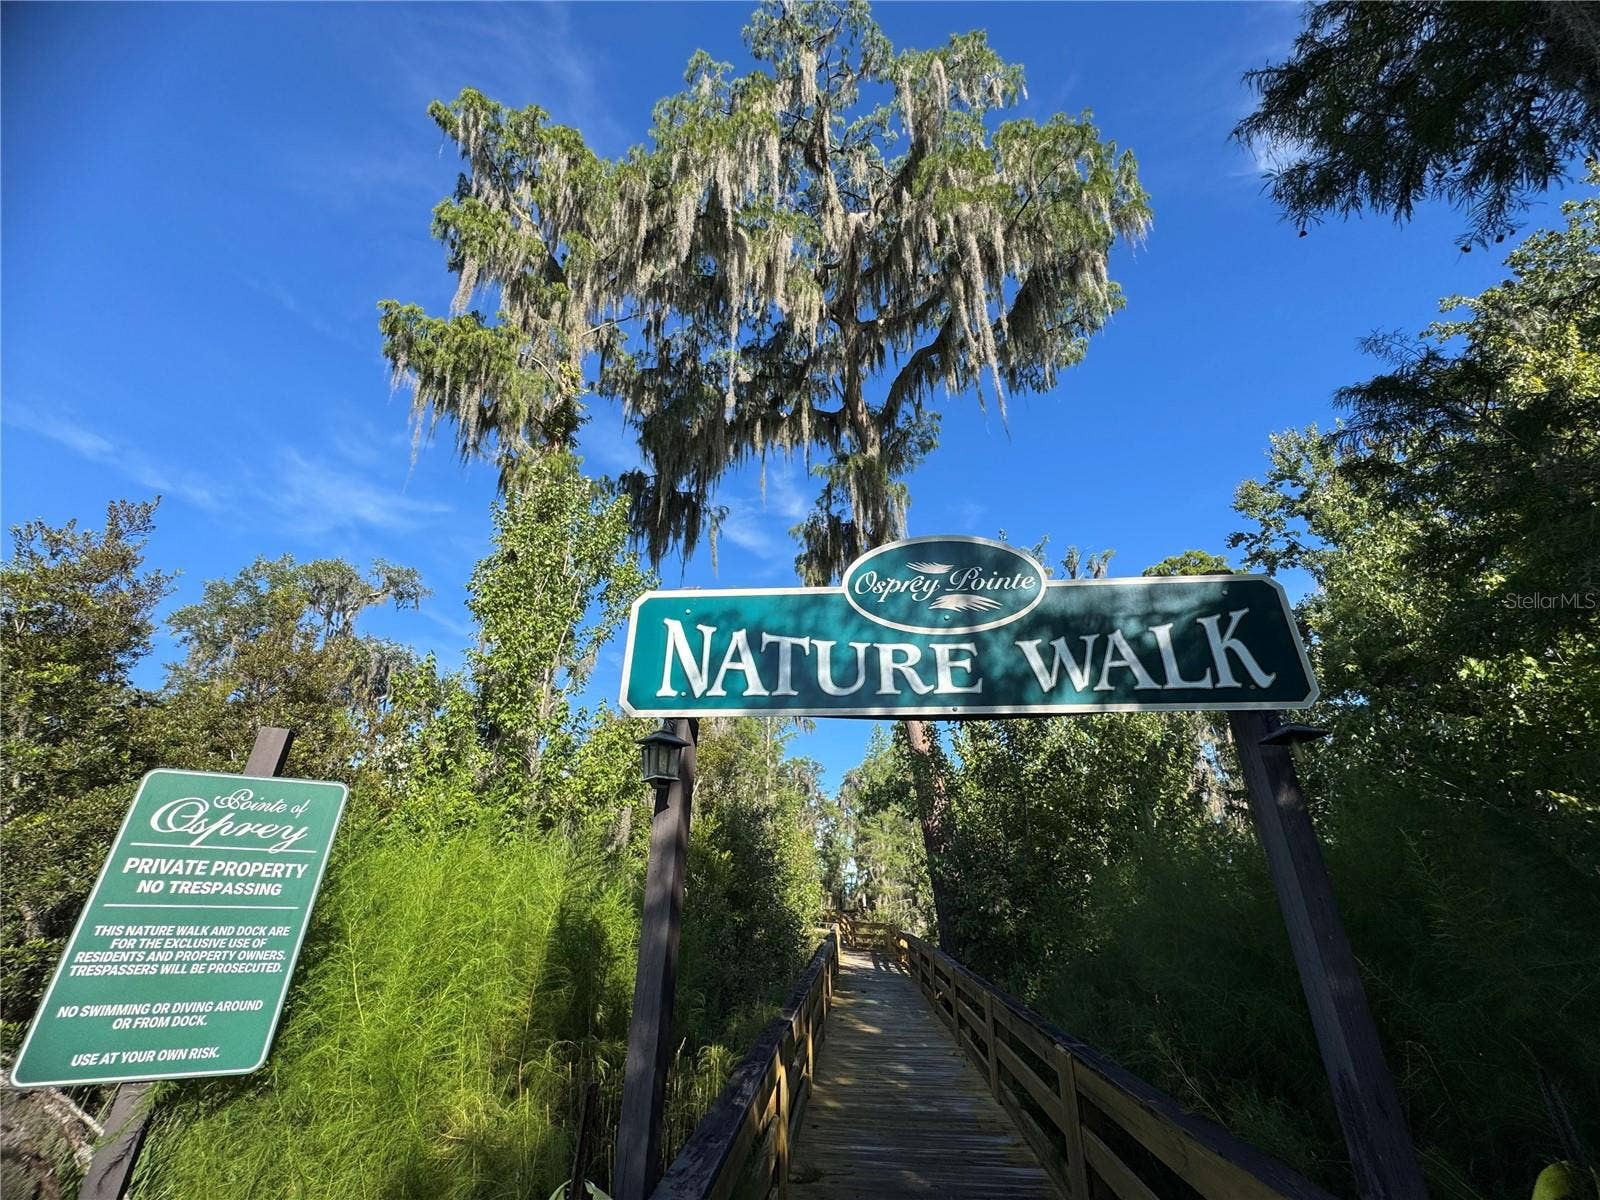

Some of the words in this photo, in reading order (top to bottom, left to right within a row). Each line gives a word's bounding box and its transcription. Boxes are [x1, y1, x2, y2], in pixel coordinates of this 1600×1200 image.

[854, 570, 940, 603] Osprey
[945, 566, 1036, 592] Pointe
[656, 617, 983, 700] NATURE
[1015, 607, 1276, 693] WALK
[214, 788, 287, 814] Pointe
[291, 799, 311, 819] of
[150, 797, 308, 854] Osprey
[122, 857, 210, 876] PRIVATE
[210, 861, 309, 879] PROPERTY
[136, 880, 164, 894] NO
[169, 880, 282, 896] TRESPASSING
[94, 925, 125, 936] THIS
[125, 925, 175, 937] NATURE
[176, 926, 209, 936] WALK
[209, 926, 235, 936] AND
[236, 926, 269, 936] DOCK
[269, 926, 291, 936] ARE
[110, 938, 136, 949] FOR
[139, 938, 163, 949] THE
[164, 938, 227, 949] EXCLUSIVE
[228, 938, 251, 948] USE
[251, 938, 267, 948] OF
[73, 951, 145, 963] RESIDENTS
[146, 951, 174, 962] AND
[175, 951, 236, 961] PROPERTY
[237, 950, 286, 961] OWNERS.
[69, 964, 158, 977] TRESPASSERS
[160, 964, 188, 975] WILL
[190, 963, 206, 974] BE
[207, 962, 283, 974] PROSECUTED.
[56, 1005, 78, 1018] NO
[80, 1004, 150, 1017] SWIMMING
[152, 1002, 171, 1014] OR
[172, 1001, 213, 1014] DIVING
[214, 1000, 263, 1012] AROUND
[112, 1018, 132, 1030] OR
[133, 1016, 170, 1029] FROM
[171, 1015, 208, 1027] DOCK.
[71, 1054, 100, 1067] USE
[99, 1052, 120, 1064] AT
[121, 1050, 154, 1063] YOUR
[155, 1049, 188, 1061] OWN
[188, 1047, 220, 1059] RISK.
